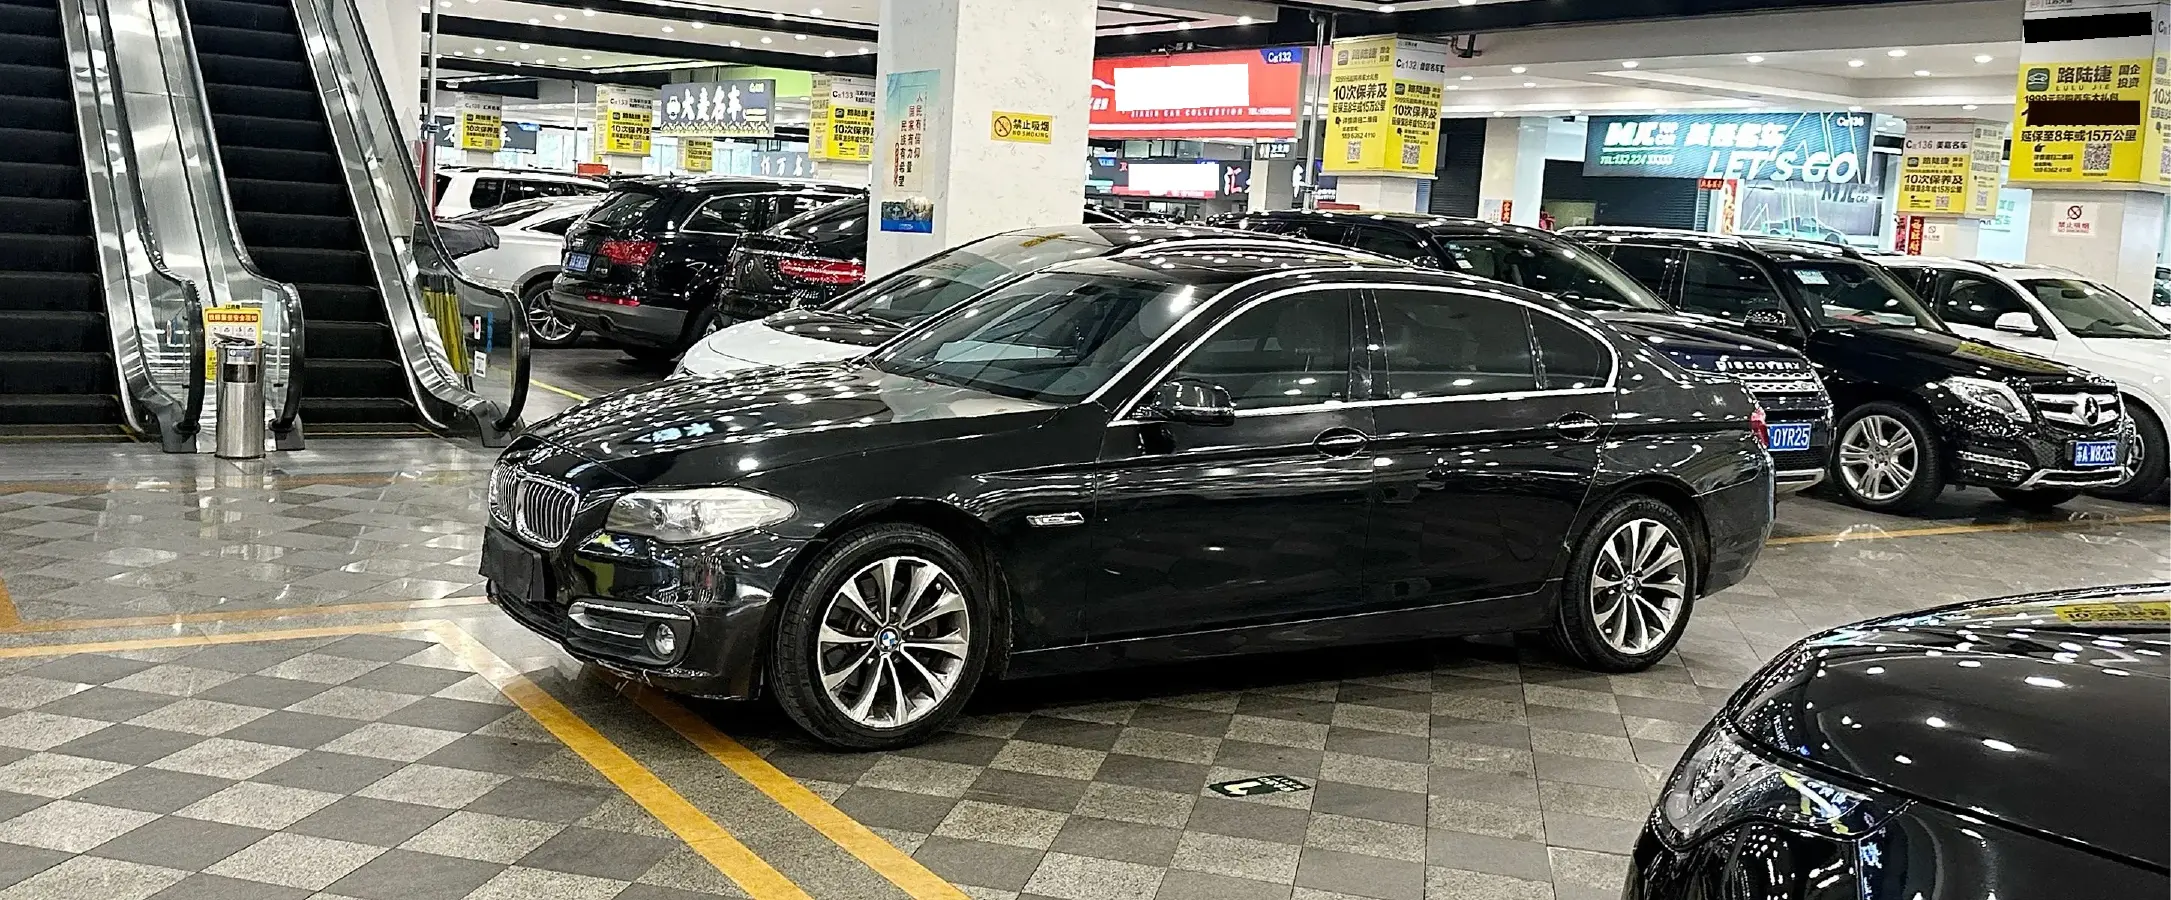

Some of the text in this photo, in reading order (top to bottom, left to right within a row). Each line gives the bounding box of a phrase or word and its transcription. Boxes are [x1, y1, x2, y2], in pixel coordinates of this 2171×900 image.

[2056, 65, 2113, 84] 路陆捷
[2118, 64, 2141, 76] 国企
[2117, 77, 2140, 89] 投资
[1333, 83, 1388, 101] 10次保养及
[1163, 109, 1180, 117] CAR
[1185, 107, 1243, 116] COLLECTION
[1393, 104, 1438, 119] 10次保养及
[611, 125, 650, 134] 10次保养及
[1012, 118, 1050, 132] 禁止吸烟
[2021, 130, 2137, 142] 延保至8年或15万公里
[1703, 151, 1858, 183] LET'S GO
[1904, 174, 1963, 185] 10次保养及
[2058, 221, 2090, 230] 禁止吸烟
[1715, 360, 1800, 371] DISCOVERY
